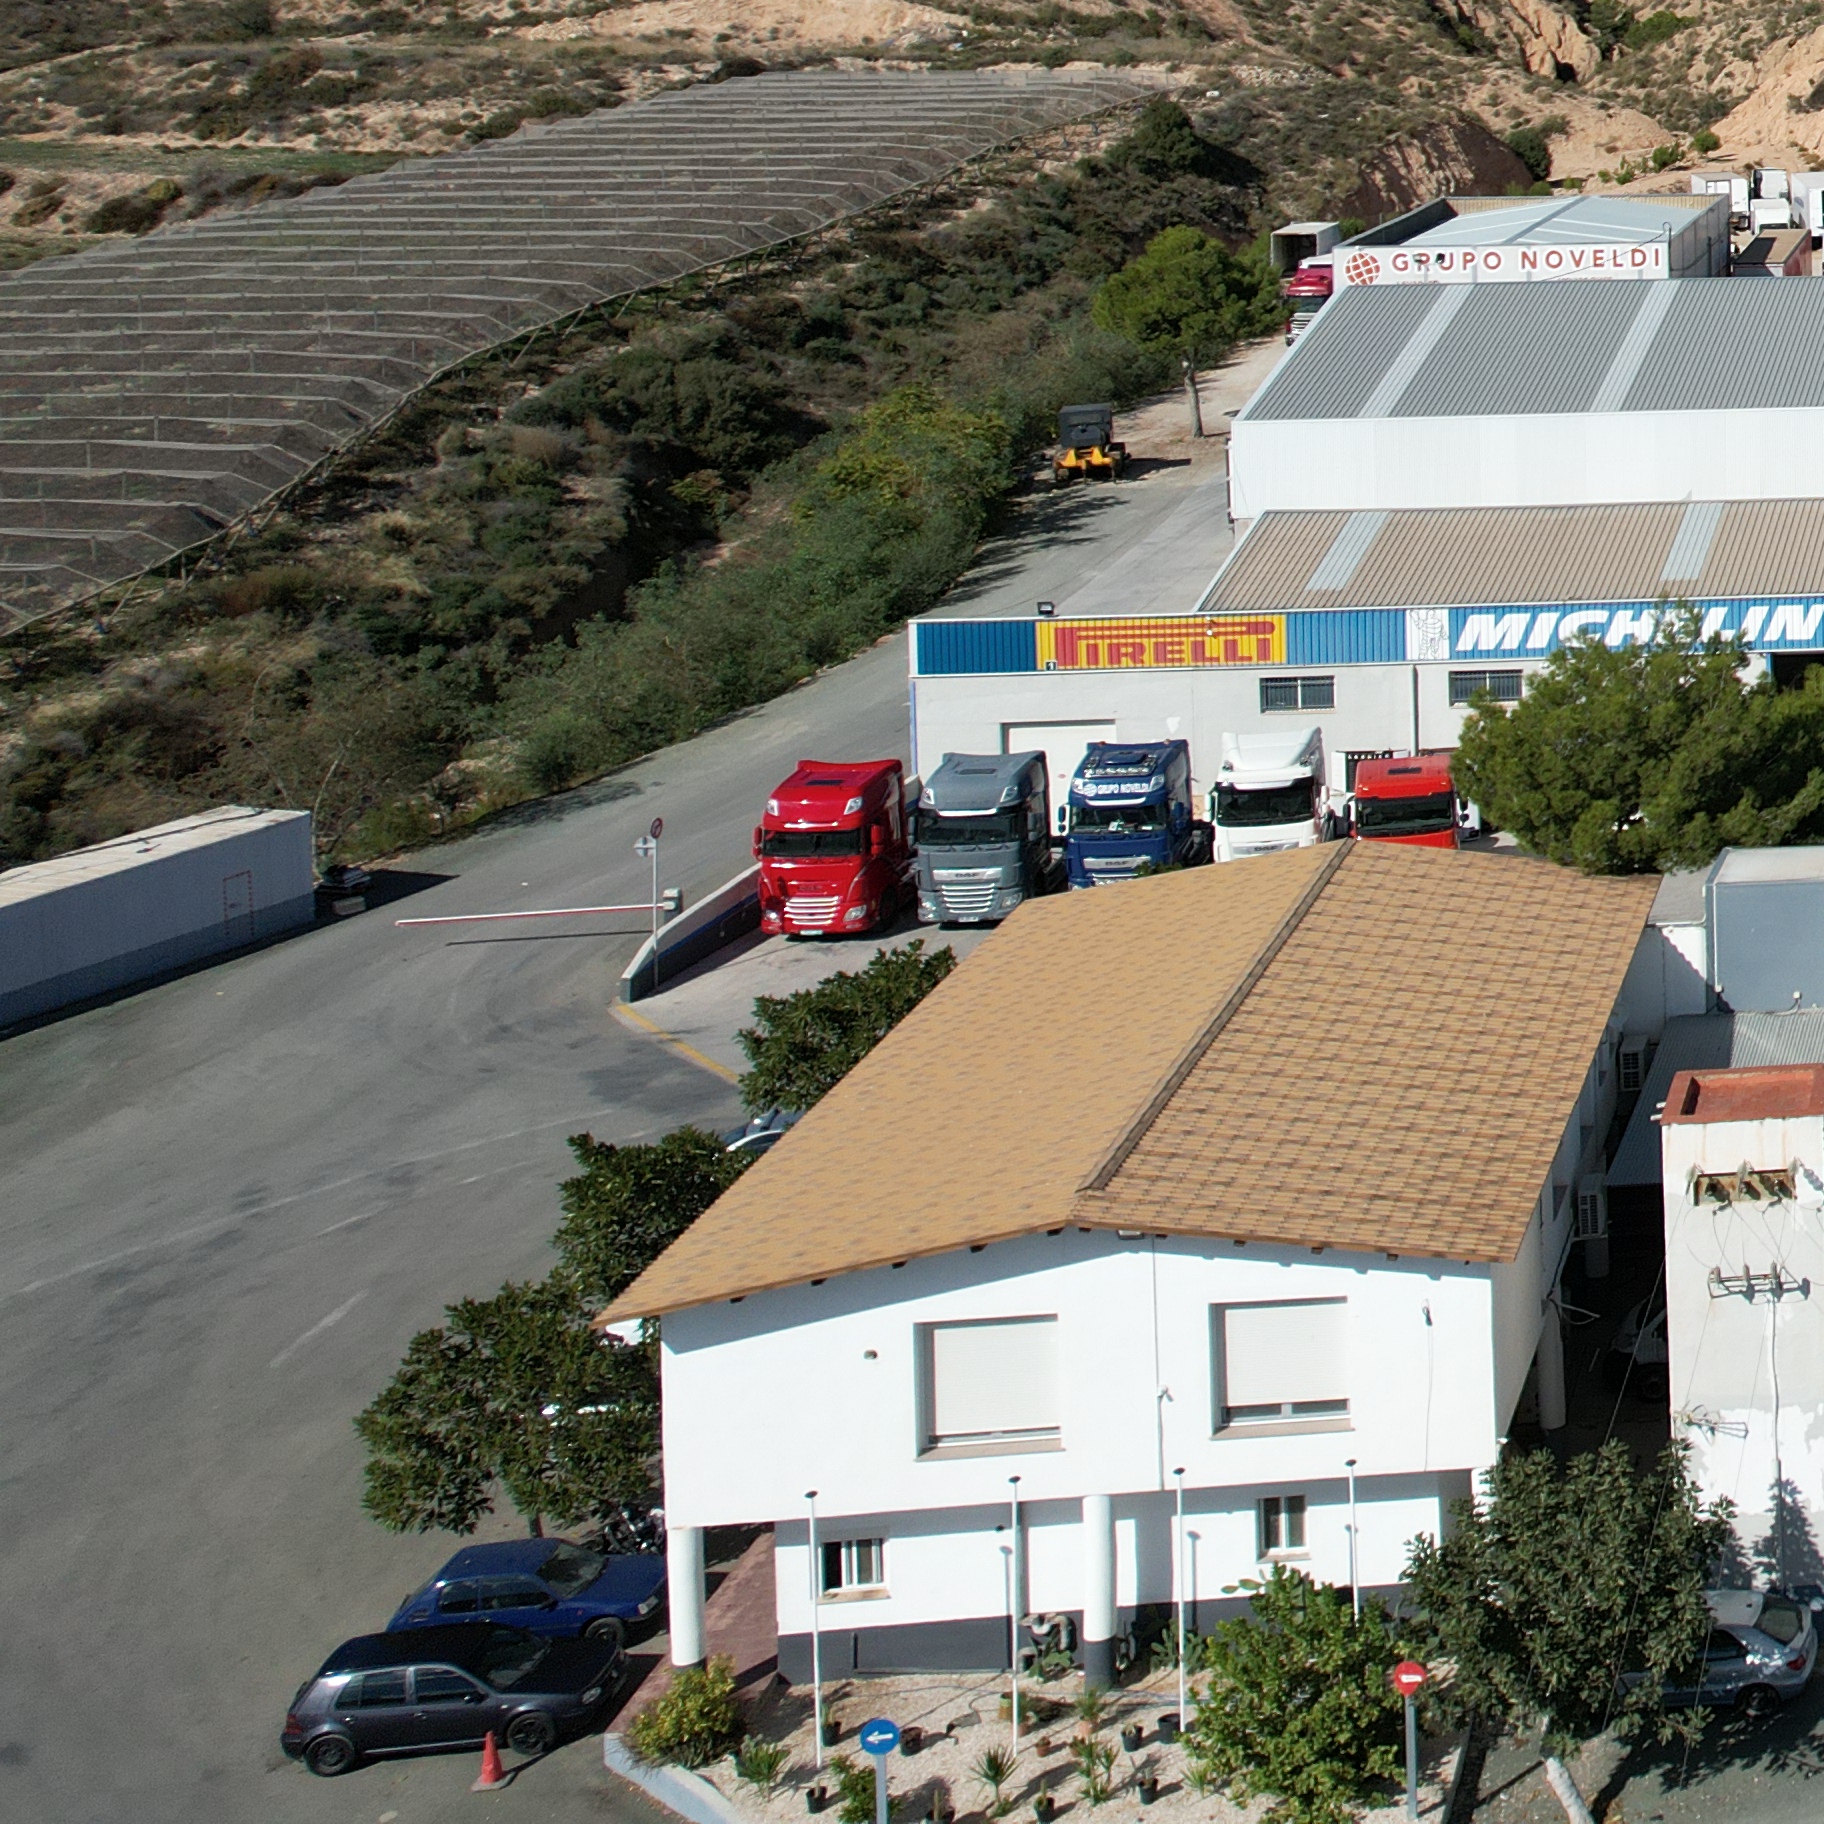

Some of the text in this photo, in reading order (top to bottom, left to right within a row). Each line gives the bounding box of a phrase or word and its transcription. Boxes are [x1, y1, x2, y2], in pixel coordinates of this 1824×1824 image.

[1391, 248, 1660, 272] GRUPO NOVELDI
[1055, 621, 1276, 667] PIRELLI
